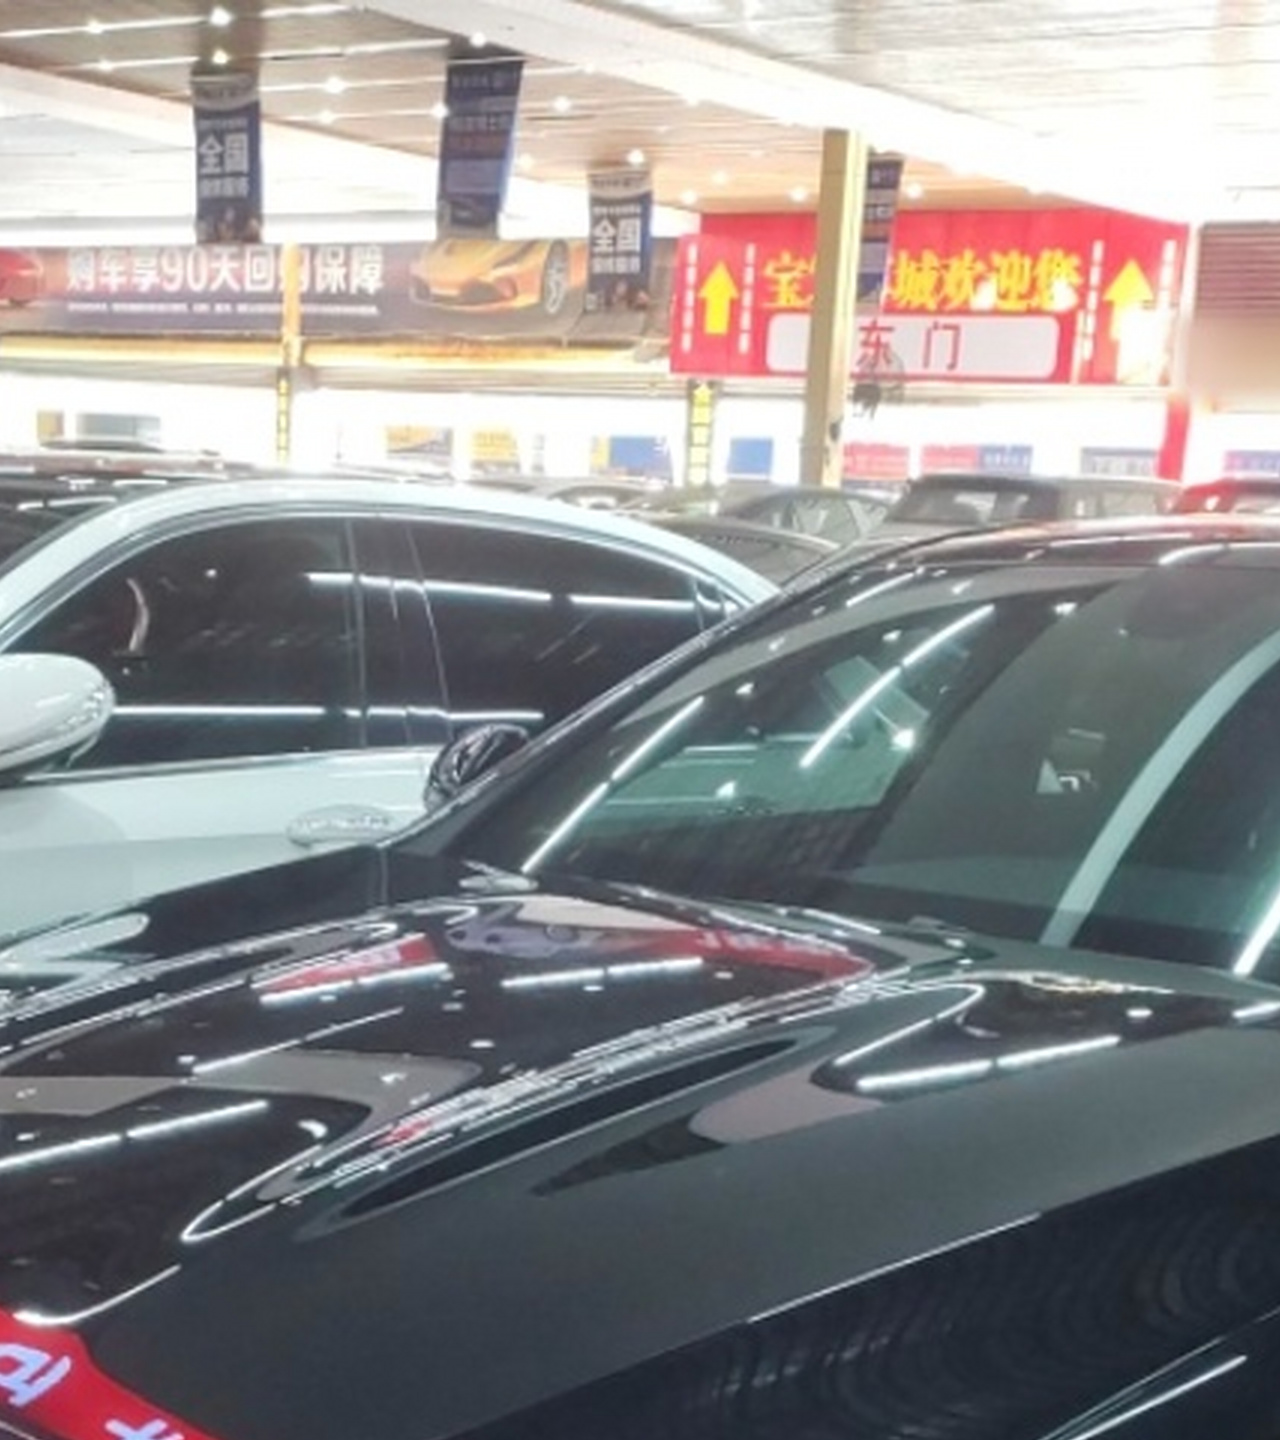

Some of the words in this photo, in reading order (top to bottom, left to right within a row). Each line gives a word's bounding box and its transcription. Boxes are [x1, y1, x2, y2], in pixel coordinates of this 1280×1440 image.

[199, 132, 249, 175] 全国
[593, 219, 641, 253] 全国
[763, 248, 1084, 312] 宝城欢迎您
[856, 320, 962, 371] 东门
